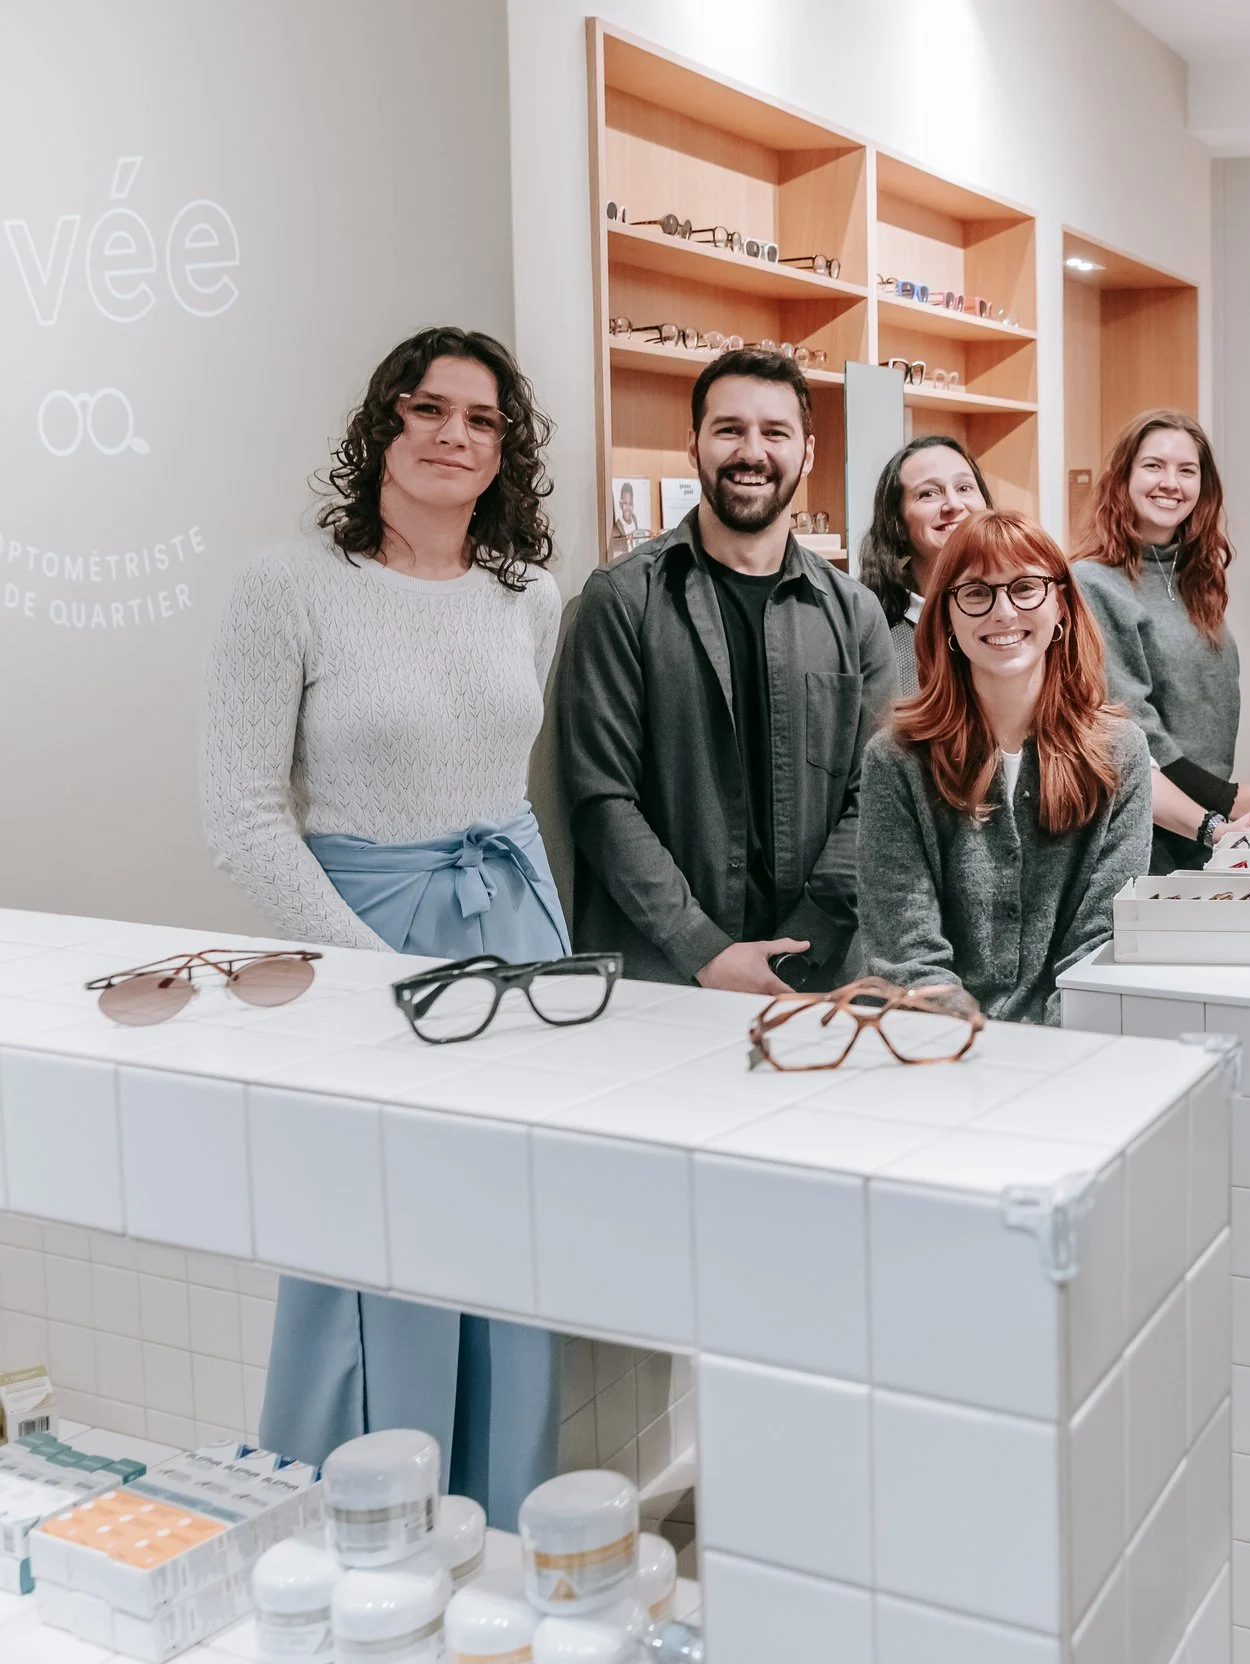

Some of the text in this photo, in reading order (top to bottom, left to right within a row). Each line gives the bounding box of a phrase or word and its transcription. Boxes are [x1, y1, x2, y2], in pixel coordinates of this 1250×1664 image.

[3, 155, 241, 327] vée
[5, 582, 192, 629] DE QUARTIER
